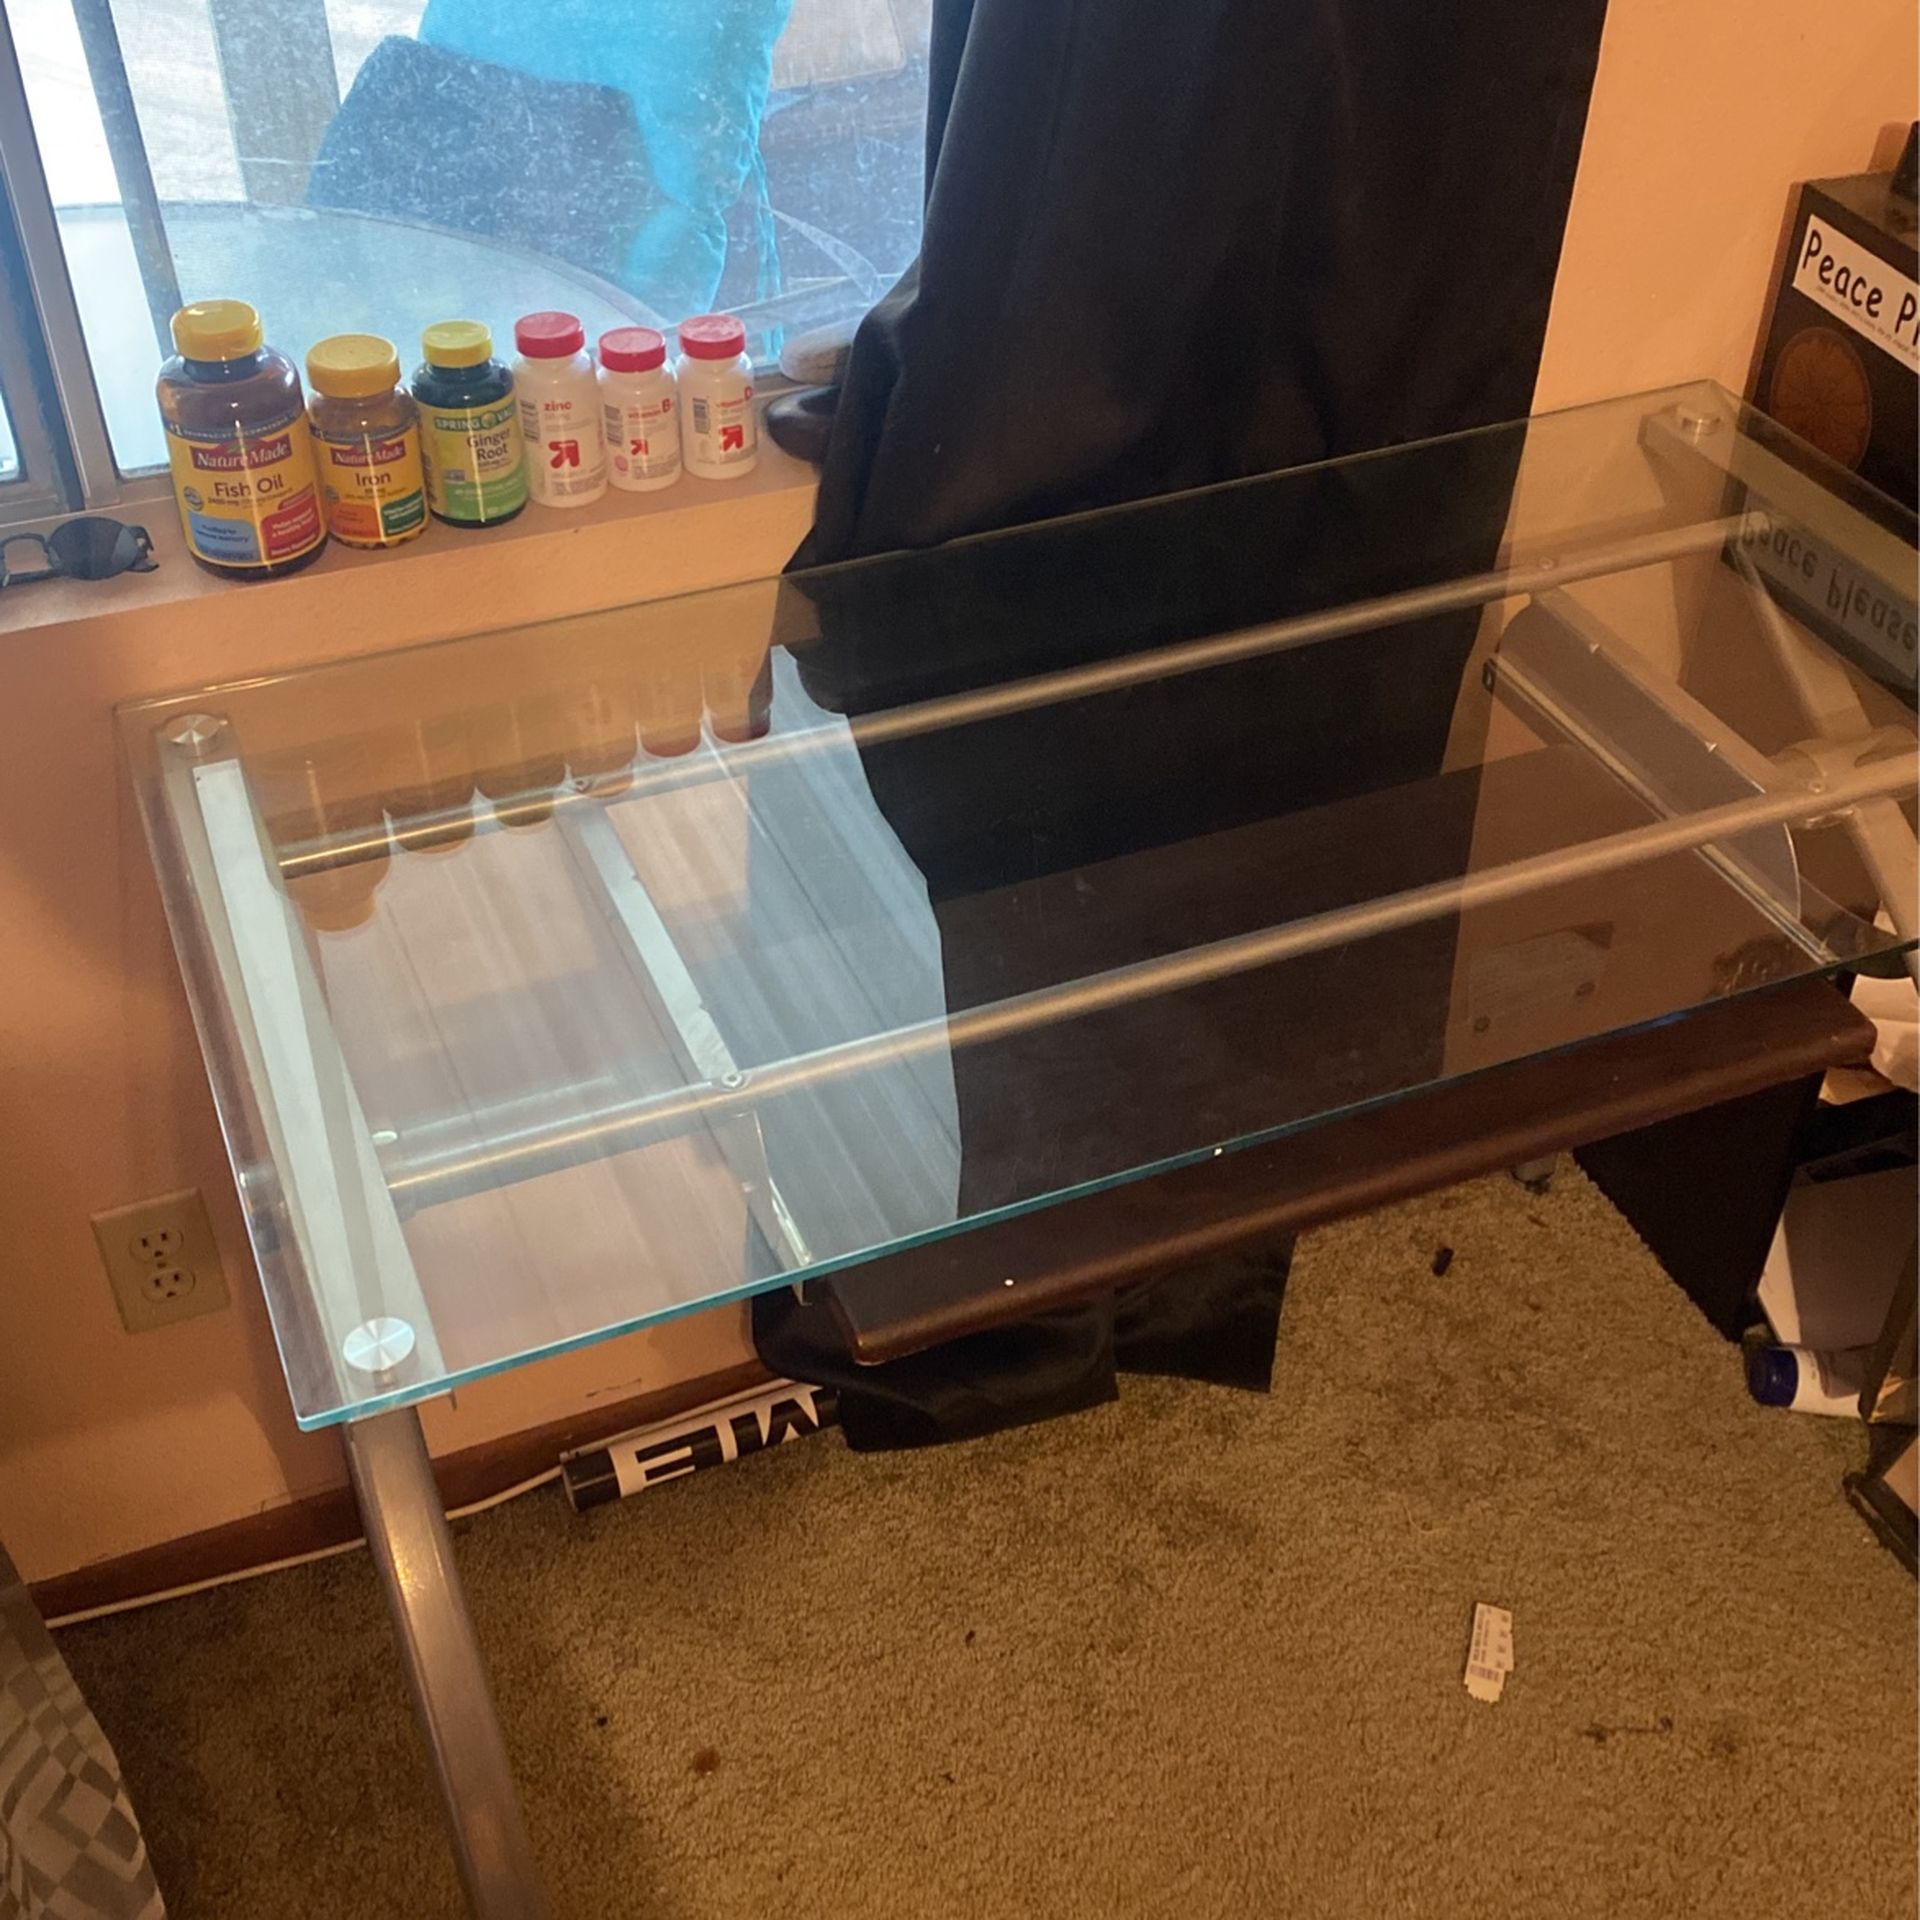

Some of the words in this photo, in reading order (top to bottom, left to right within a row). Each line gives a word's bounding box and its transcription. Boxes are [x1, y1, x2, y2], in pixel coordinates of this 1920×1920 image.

[1802, 229, 1883, 318] Peace
[544, 401, 572, 411] zinc
[435, 417, 481, 431] SPRING
[467, 428, 510, 448] Ginger
[477, 443, 508, 460] Root
[214, 480, 250, 498] Fish
[257, 474, 284, 493] Oil
[355, 471, 391, 487] Iron
